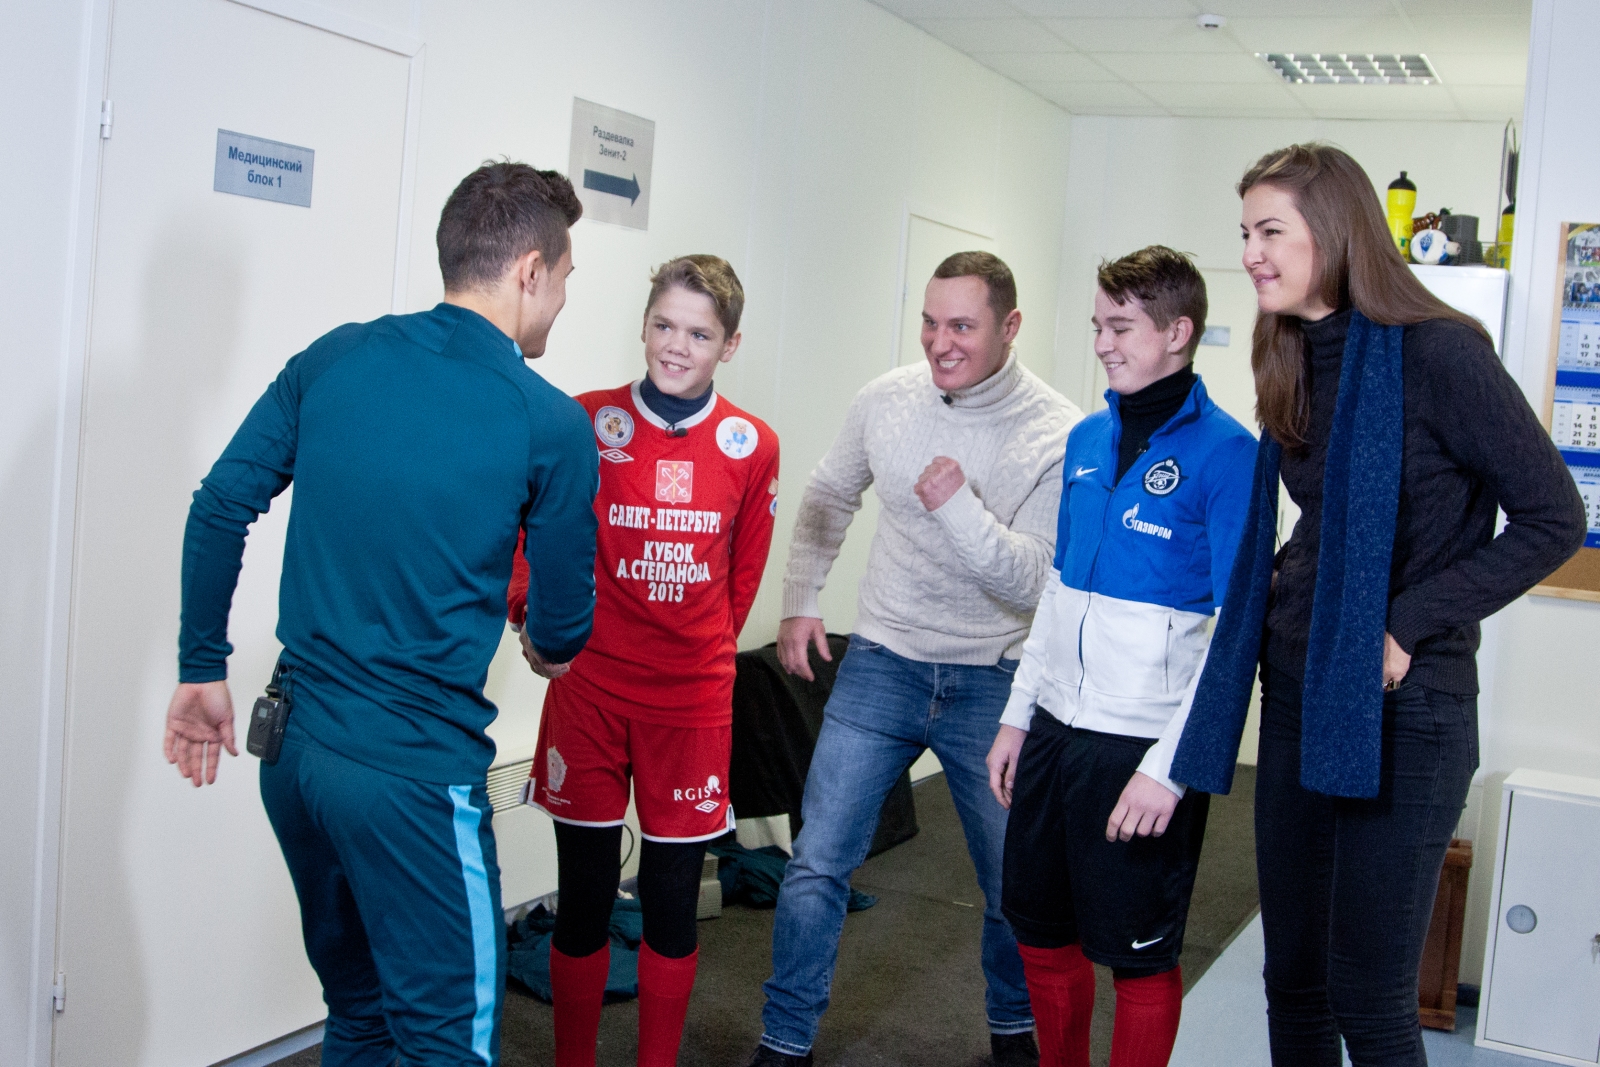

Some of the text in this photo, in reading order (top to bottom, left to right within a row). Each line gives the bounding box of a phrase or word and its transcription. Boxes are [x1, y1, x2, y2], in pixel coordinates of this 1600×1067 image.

[593, 125, 634, 147] Раздевалка
[228, 145, 303, 173] Медицинский
[599, 143, 627, 161] Зенит-2
[247, 169, 283, 188] блок 1
[608, 503, 722, 534] САНКТ-ПЕТЕРБУРГ
[1133, 519, 1172, 540] ГАЗПРОМ
[643, 540, 695, 564] КУБОК
[616, 558, 711, 584] А.СТЕПАНОВА
[647, 582, 685, 603] 2013
[673, 785, 711, 801] RGIS
